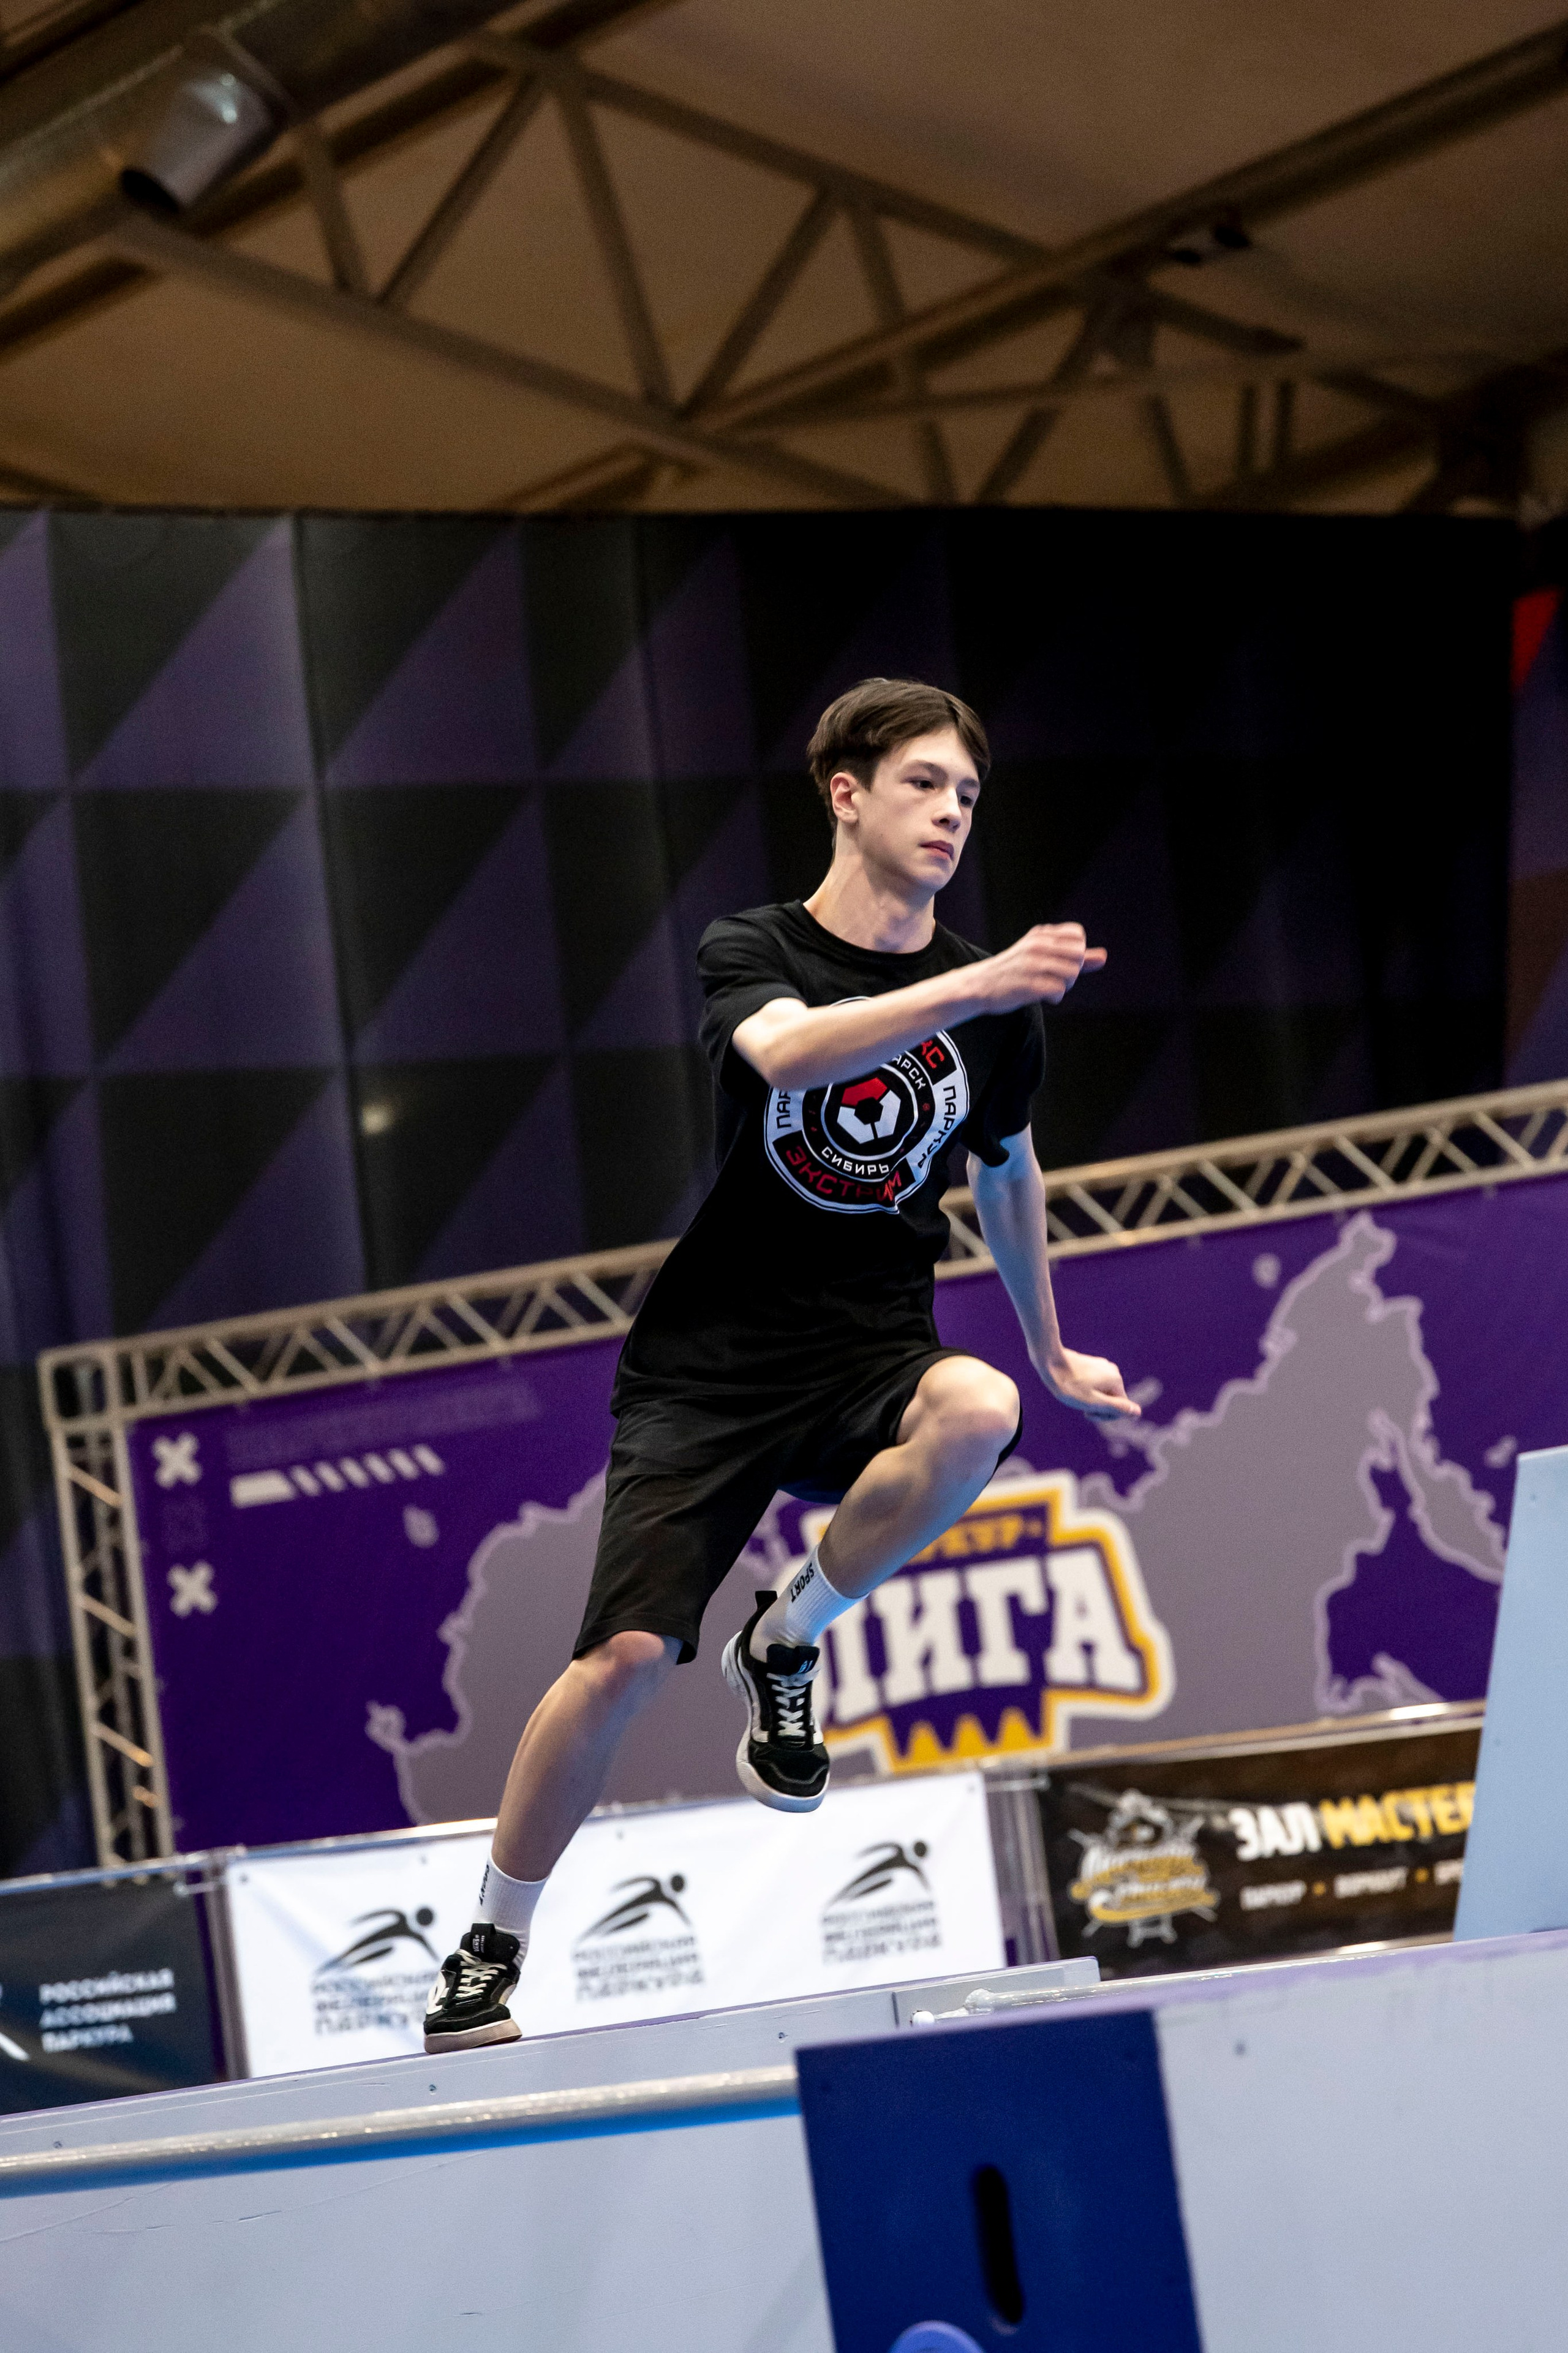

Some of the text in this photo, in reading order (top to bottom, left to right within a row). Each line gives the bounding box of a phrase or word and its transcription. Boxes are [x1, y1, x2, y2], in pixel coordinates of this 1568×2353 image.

[786, 1146, 902, 1202] ЭКСТРИМ
[821, 1146, 889, 1176] СИБИРЬ
[791, 1562, 815, 1604] SPORT
[1229, 1801, 1322, 1861] ЗАЛ
